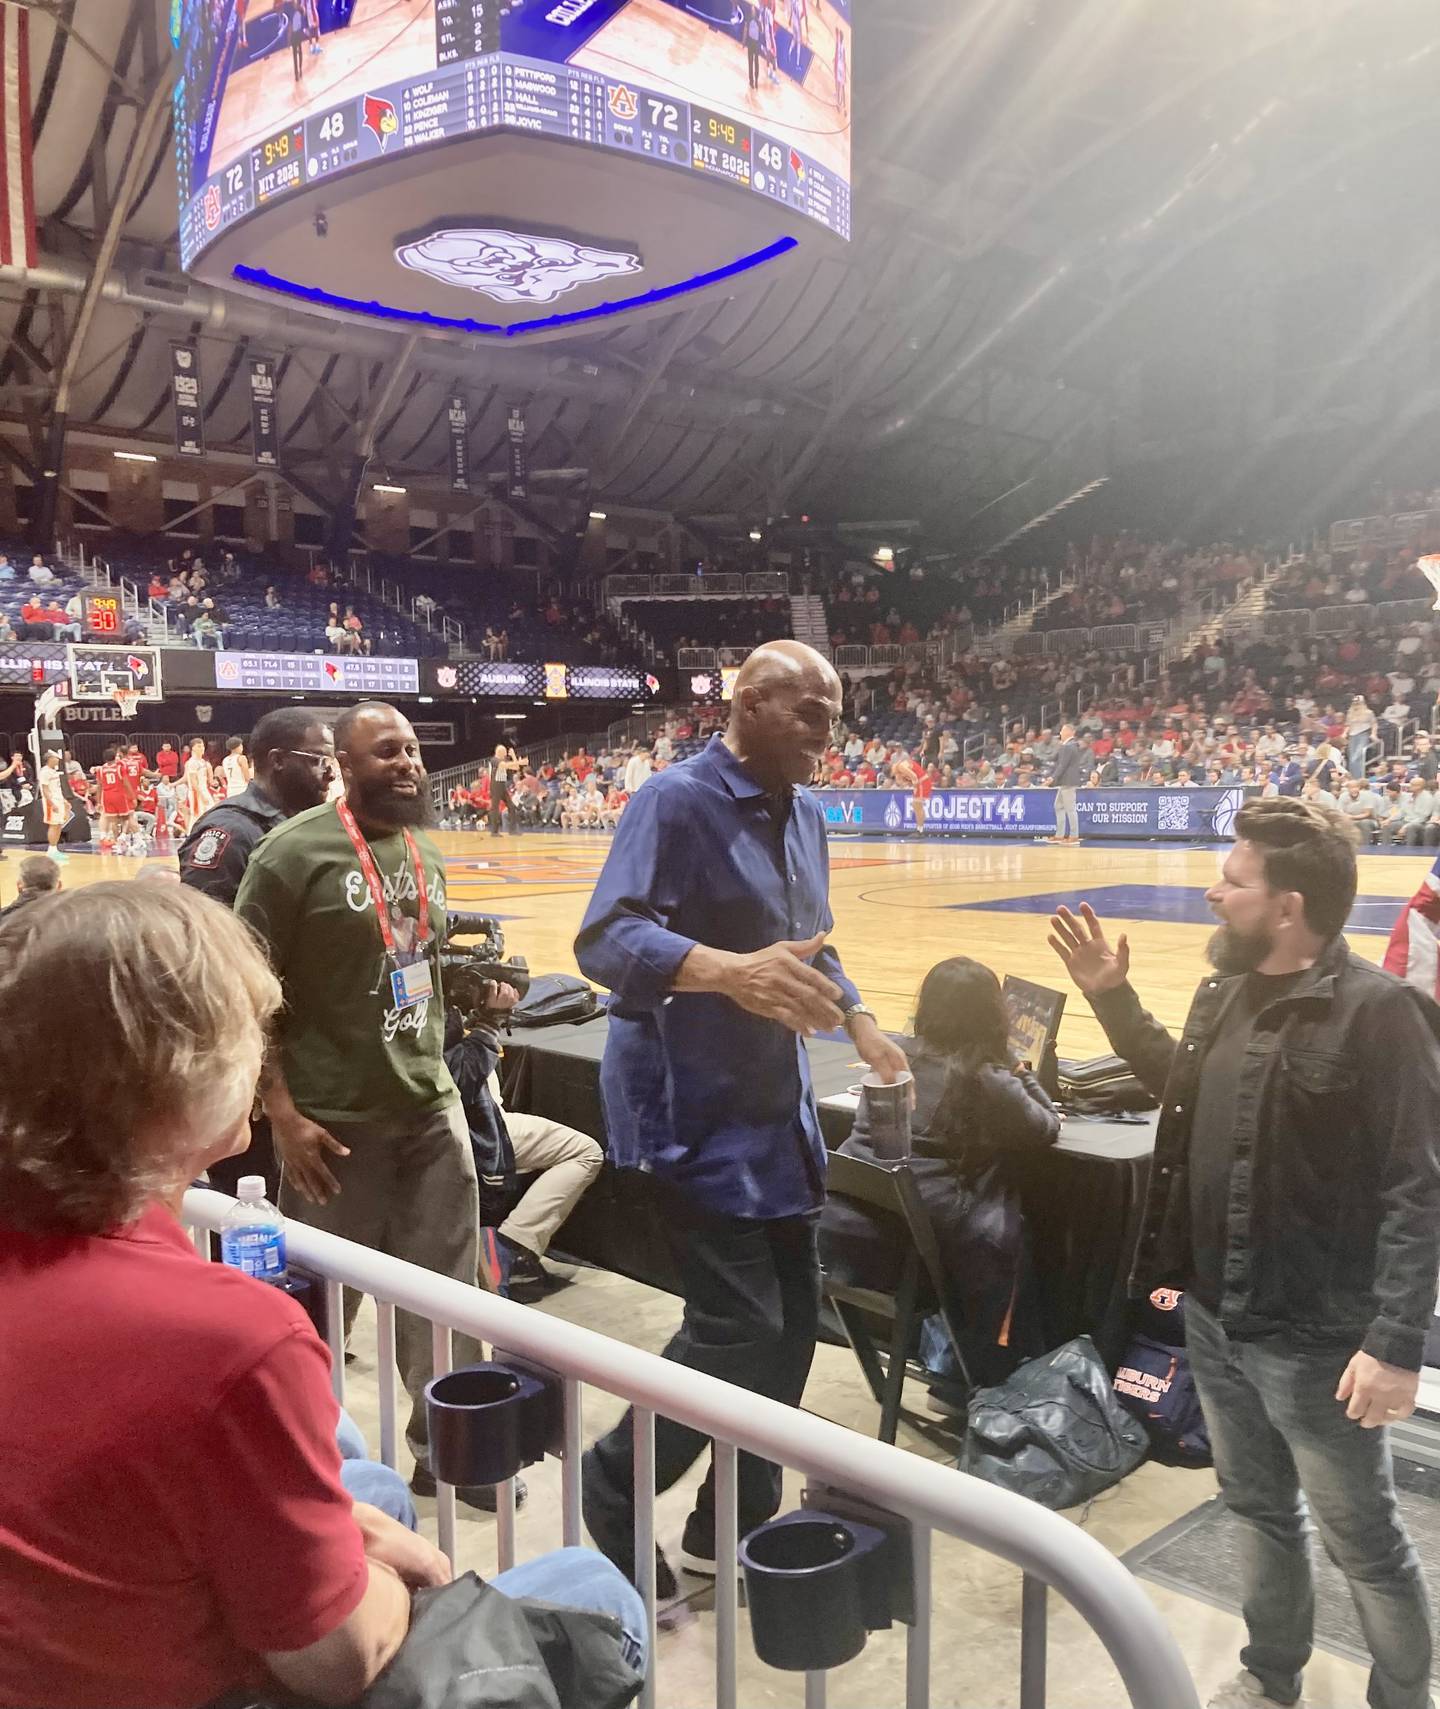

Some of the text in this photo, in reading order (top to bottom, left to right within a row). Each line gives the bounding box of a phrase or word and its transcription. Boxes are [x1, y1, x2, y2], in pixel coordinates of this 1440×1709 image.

[472, 4, 484, 18] 15
[474, 22, 482, 35] 2
[474, 39, 482, 52] 2
[515, 92, 539, 106] HALL
[648, 98, 679, 132] 72
[320, 112, 344, 141] 48
[517, 116, 542, 131] JOVIC
[693, 118, 735, 144] 2 9:49
[265, 135, 288, 165] 9:49
[644, 139, 668, 154] 2 2
[693, 142, 718, 165] NIT
[722, 153, 750, 178] 2026
[758, 143, 782, 170] 48
[255, 158, 260, 172] 2
[322, 160, 328, 170] 2
[226, 164, 243, 194] 72
[259, 173, 275, 195] NIT
[277, 161, 299, 185] 2026
[769, 184, 775, 193] 2
[93, 598, 116, 610] 9:49
[480, 673, 526, 685] AUBURN
[571, 676, 640, 689] ILLINOIS STATE
[127, 765, 138, 777] 35
[106, 774, 116, 785] 10
[997, 797, 1024, 820] 44
[1076, 802, 1148, 812] CAN TO SUPPORT
[1092, 813, 1148, 823] OUR MISSION
[384, 998, 428, 1042] Golf
